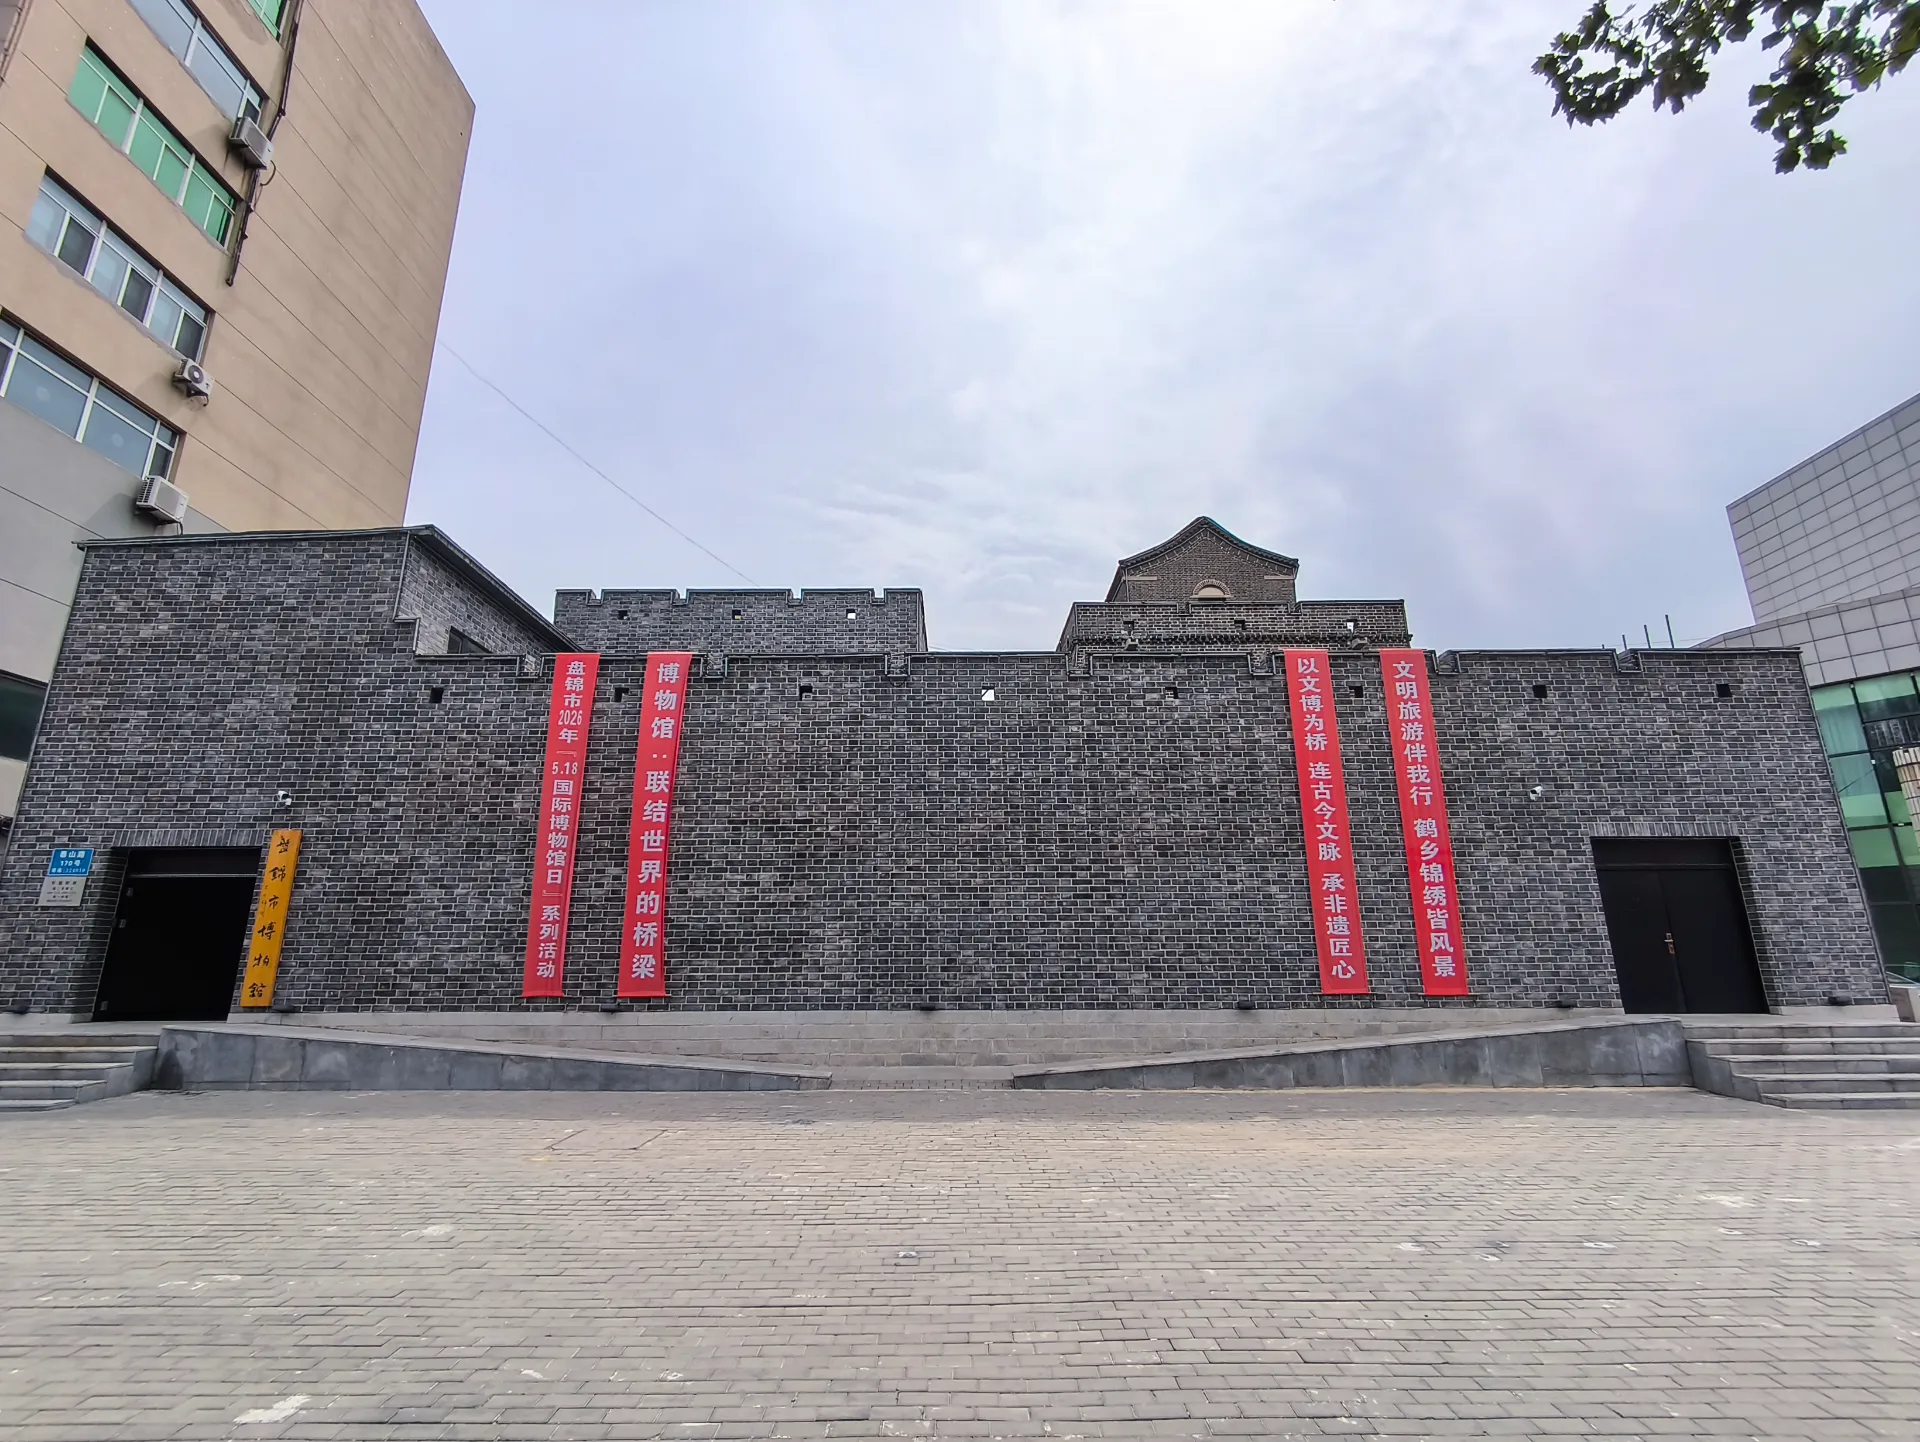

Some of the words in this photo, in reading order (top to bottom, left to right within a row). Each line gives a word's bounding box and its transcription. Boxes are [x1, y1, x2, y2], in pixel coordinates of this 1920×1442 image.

[1297, 657, 1329, 751] 以文博为桥
[1308, 761, 1342, 862] 连古今文脉
[1392, 660, 1433, 806] 文明旅游伴我行
[1413, 818, 1456, 977] 鹤乡锦绣皆风景
[1321, 873, 1356, 979] 承非遗匠心
